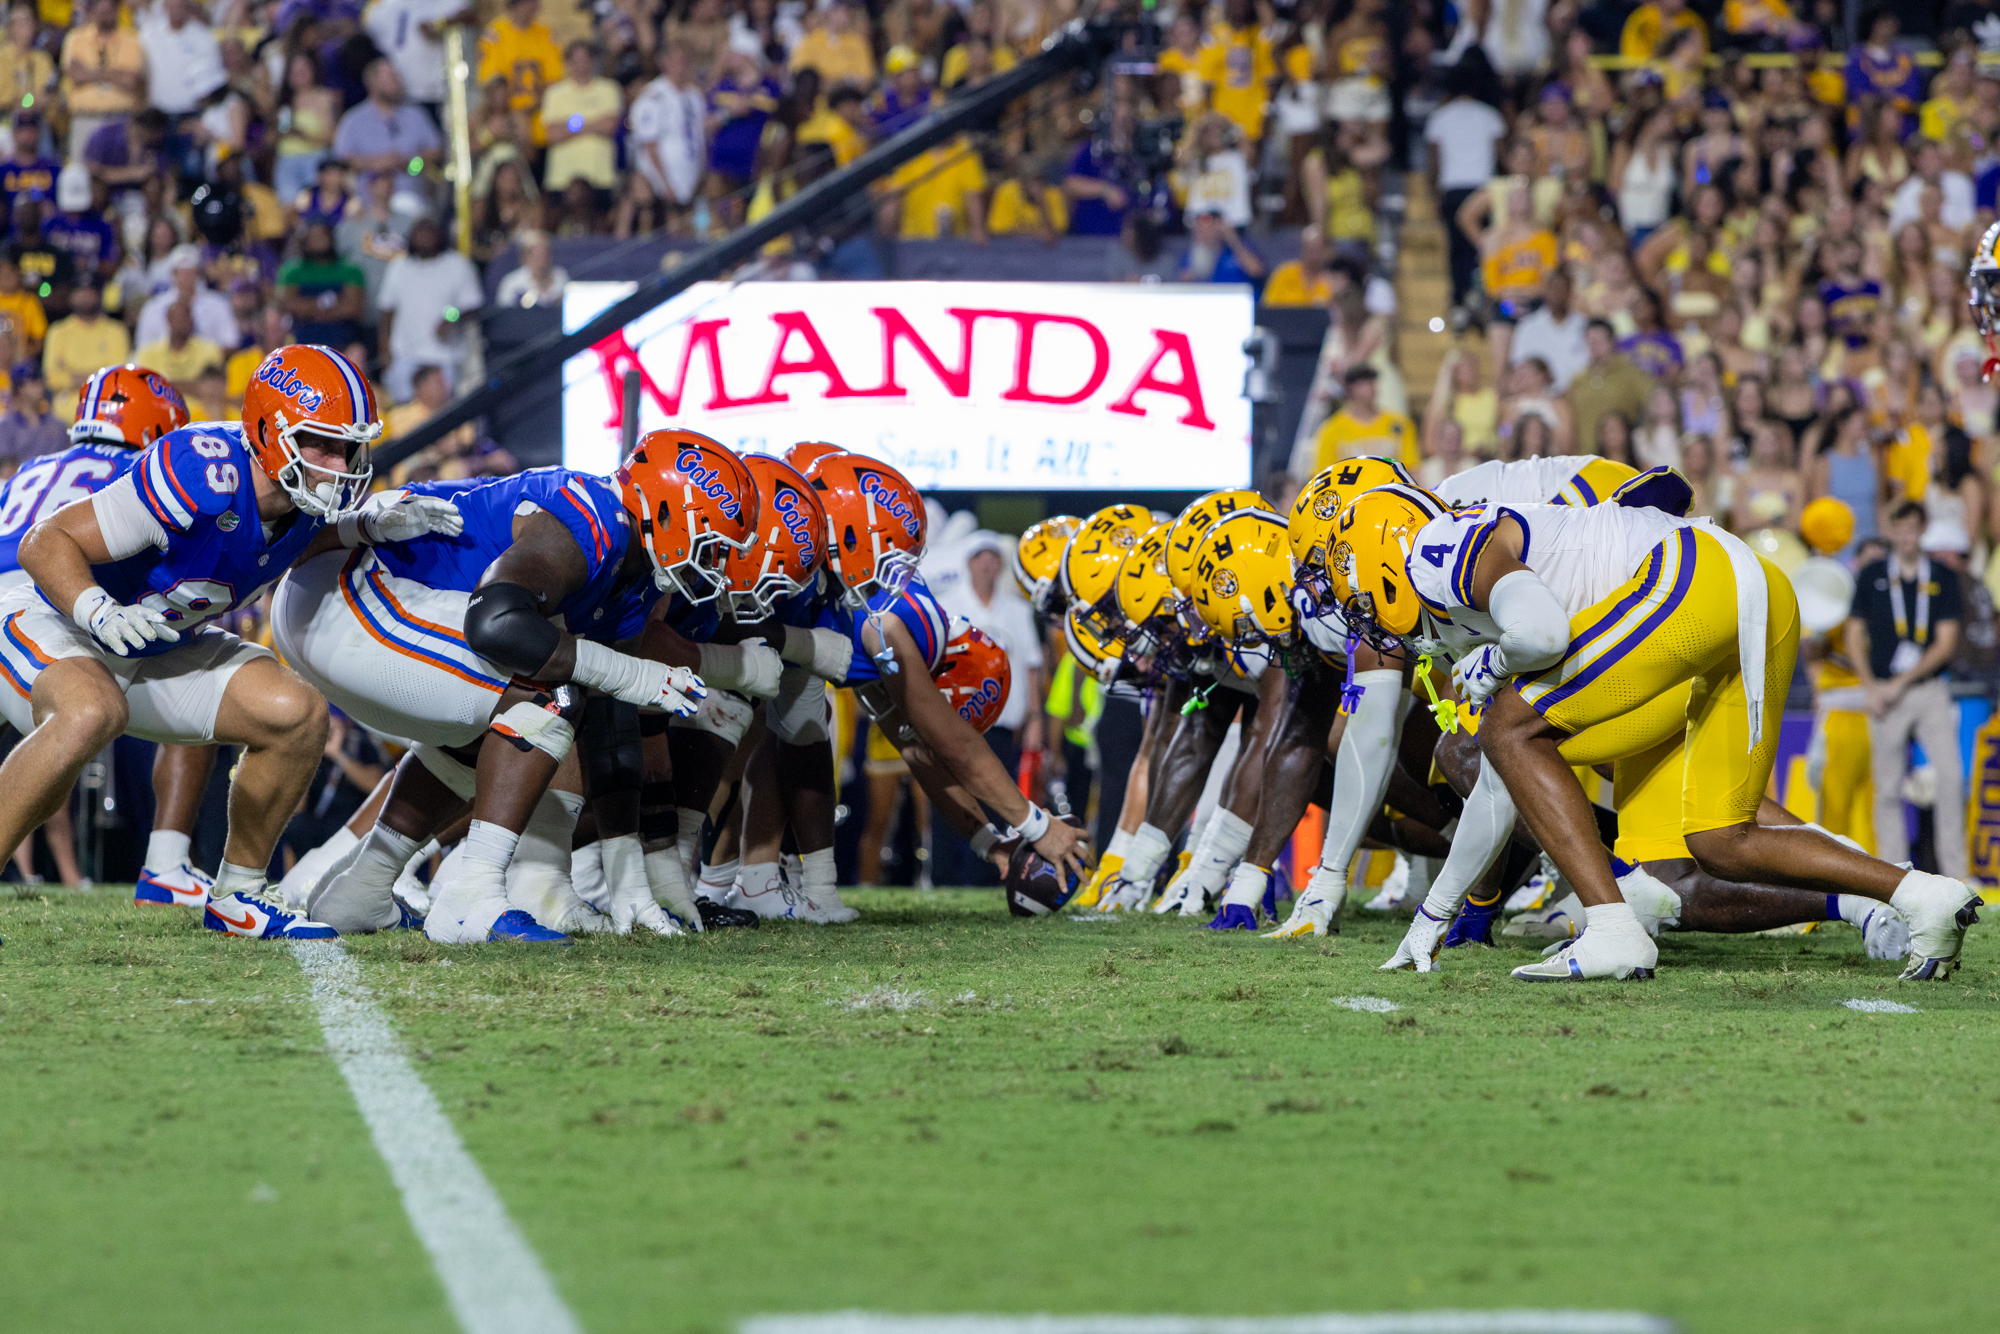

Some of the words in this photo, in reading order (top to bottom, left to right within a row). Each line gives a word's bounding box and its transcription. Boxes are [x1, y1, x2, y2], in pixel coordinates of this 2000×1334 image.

[258, 355, 323, 413] Gators
[588, 306, 1217, 431] MANDA
[75, 423, 104, 435] FLORIDA
[189, 434, 240, 495] 89
[675, 448, 742, 520] Gators
[0, 455, 117, 537] 86
[859, 471, 921, 538] Gators
[773, 488, 815, 568] Gators
[1127, 529, 1169, 579] LS
[1420, 543, 1457, 569] 4
[957, 676, 1002, 722] Gato
